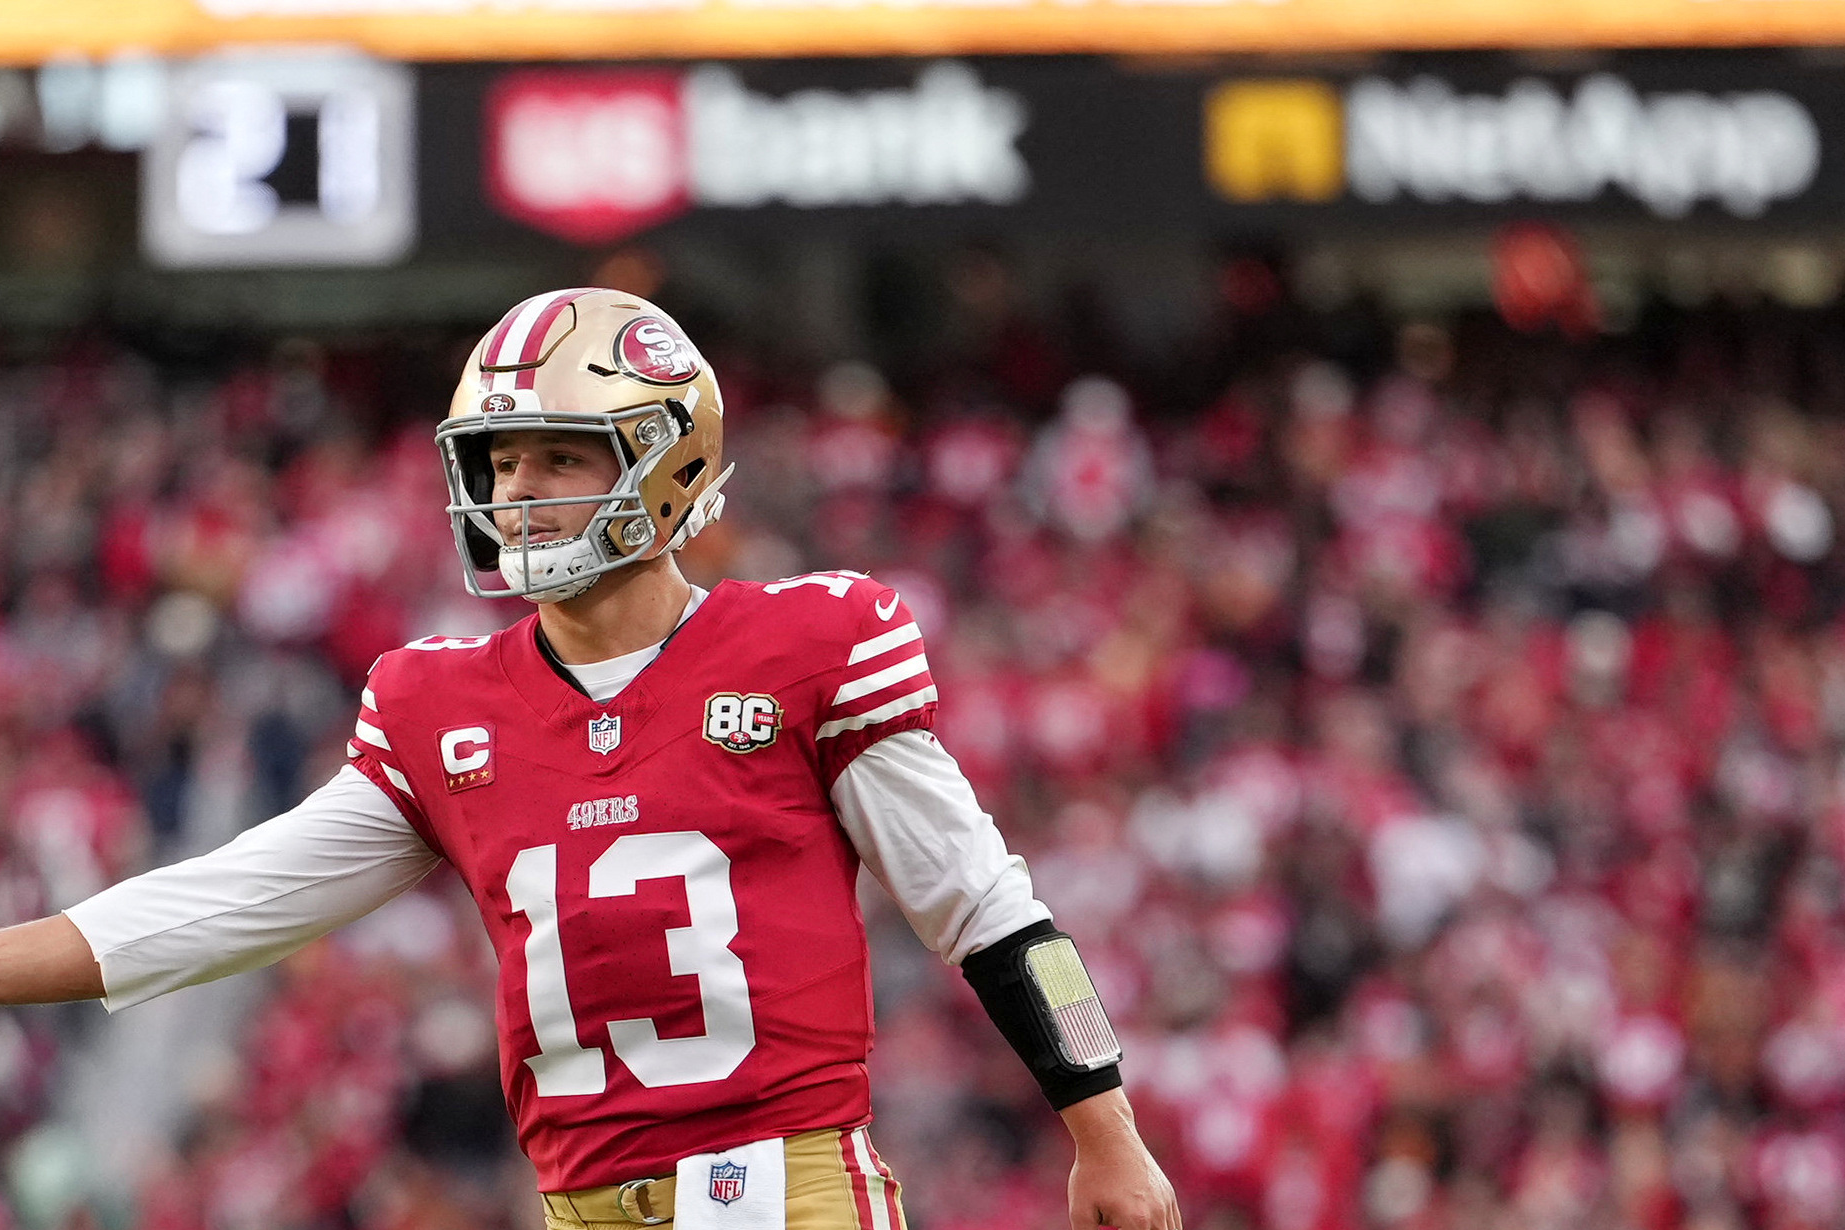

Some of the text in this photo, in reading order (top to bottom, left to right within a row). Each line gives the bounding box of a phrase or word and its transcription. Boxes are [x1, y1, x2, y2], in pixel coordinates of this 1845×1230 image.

[757, 714, 774, 723] YEARS
[440, 726, 490, 775] C
[594, 731, 616, 748] NFL
[566, 795, 639, 830] 49ERS
[506, 831, 756, 1097] 13
[713, 1180, 741, 1200] NFL
